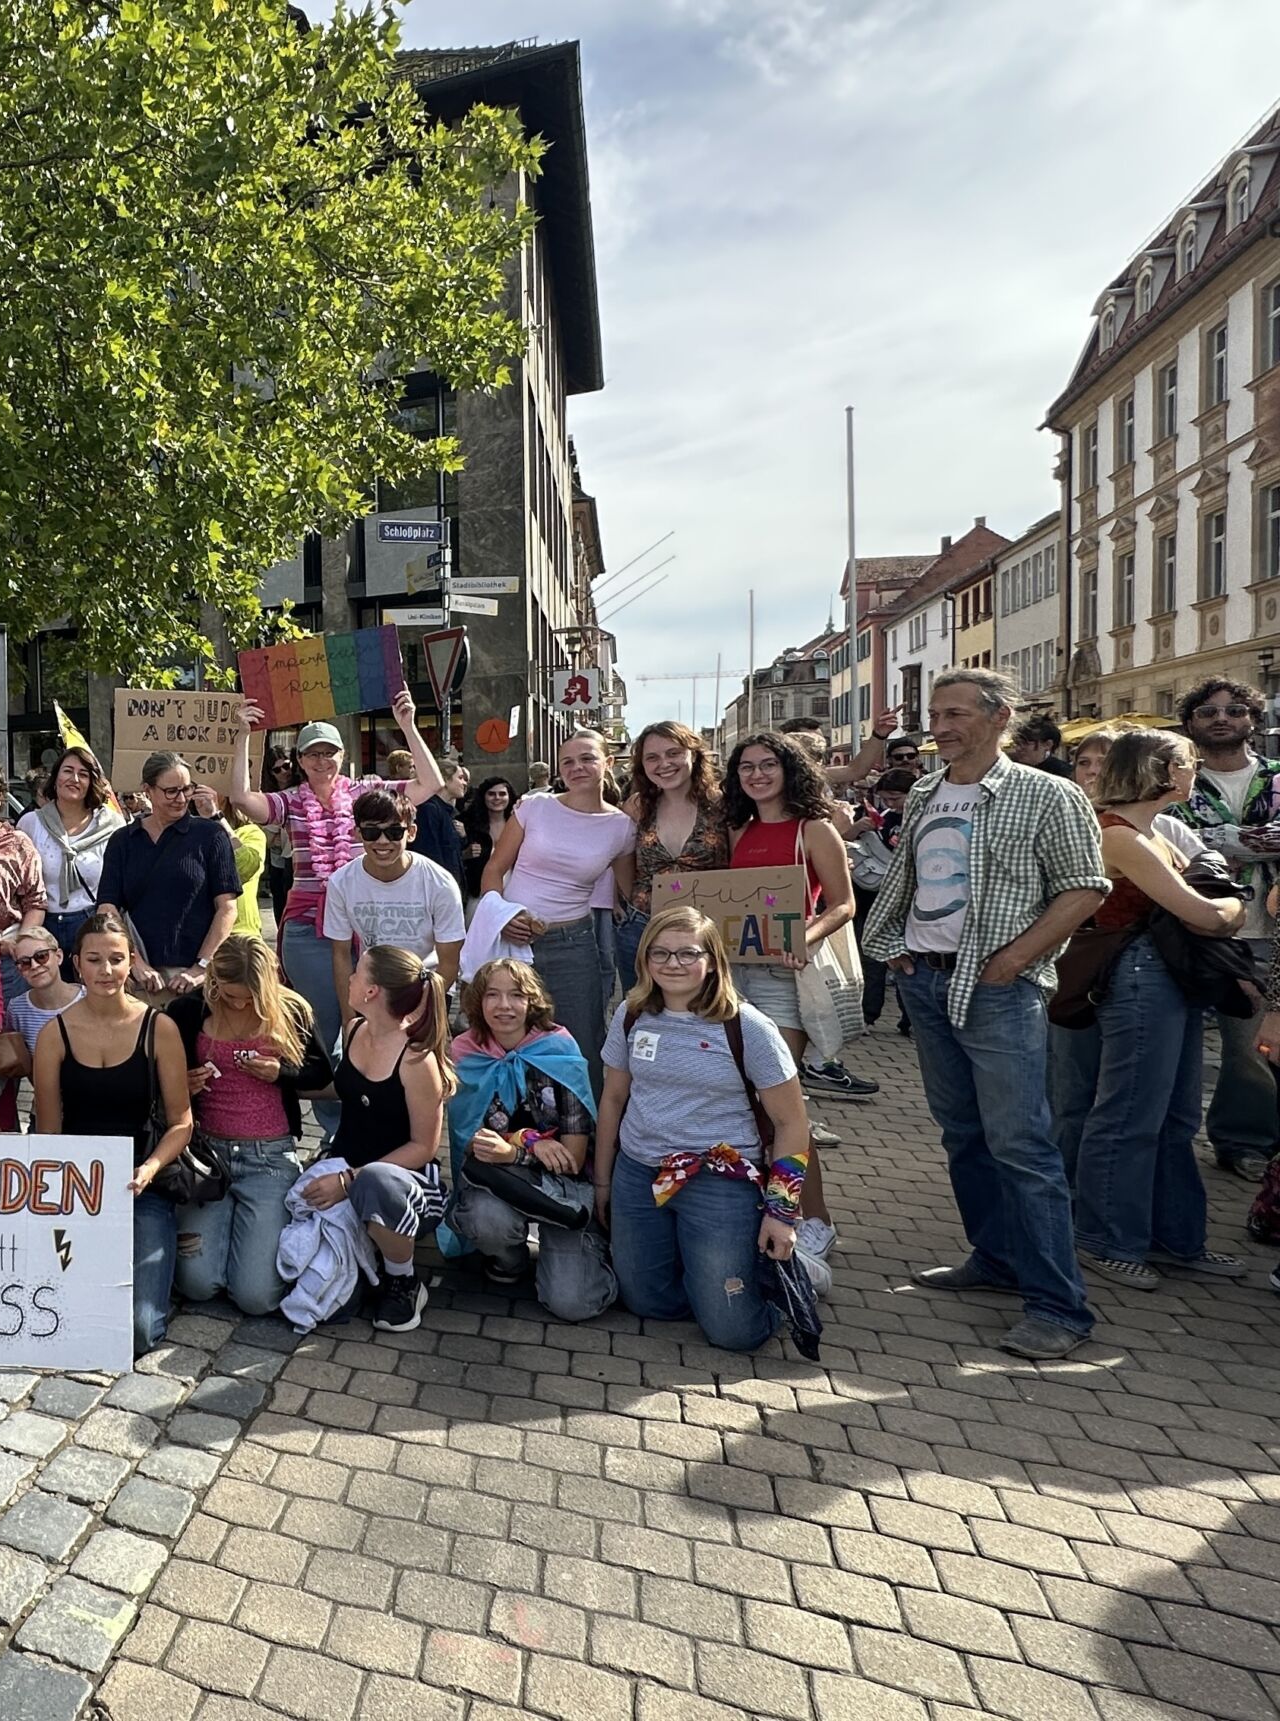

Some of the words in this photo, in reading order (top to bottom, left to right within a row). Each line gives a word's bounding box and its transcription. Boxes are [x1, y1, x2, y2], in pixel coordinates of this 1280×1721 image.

[384, 525, 435, 539] Schloßplatz
[128, 698, 186, 718] DON'T
[194, 700, 242, 723] JUDG
[142, 724, 159, 742] A
[166, 723, 210, 743] BOOK
[216, 726, 240, 745] BY
